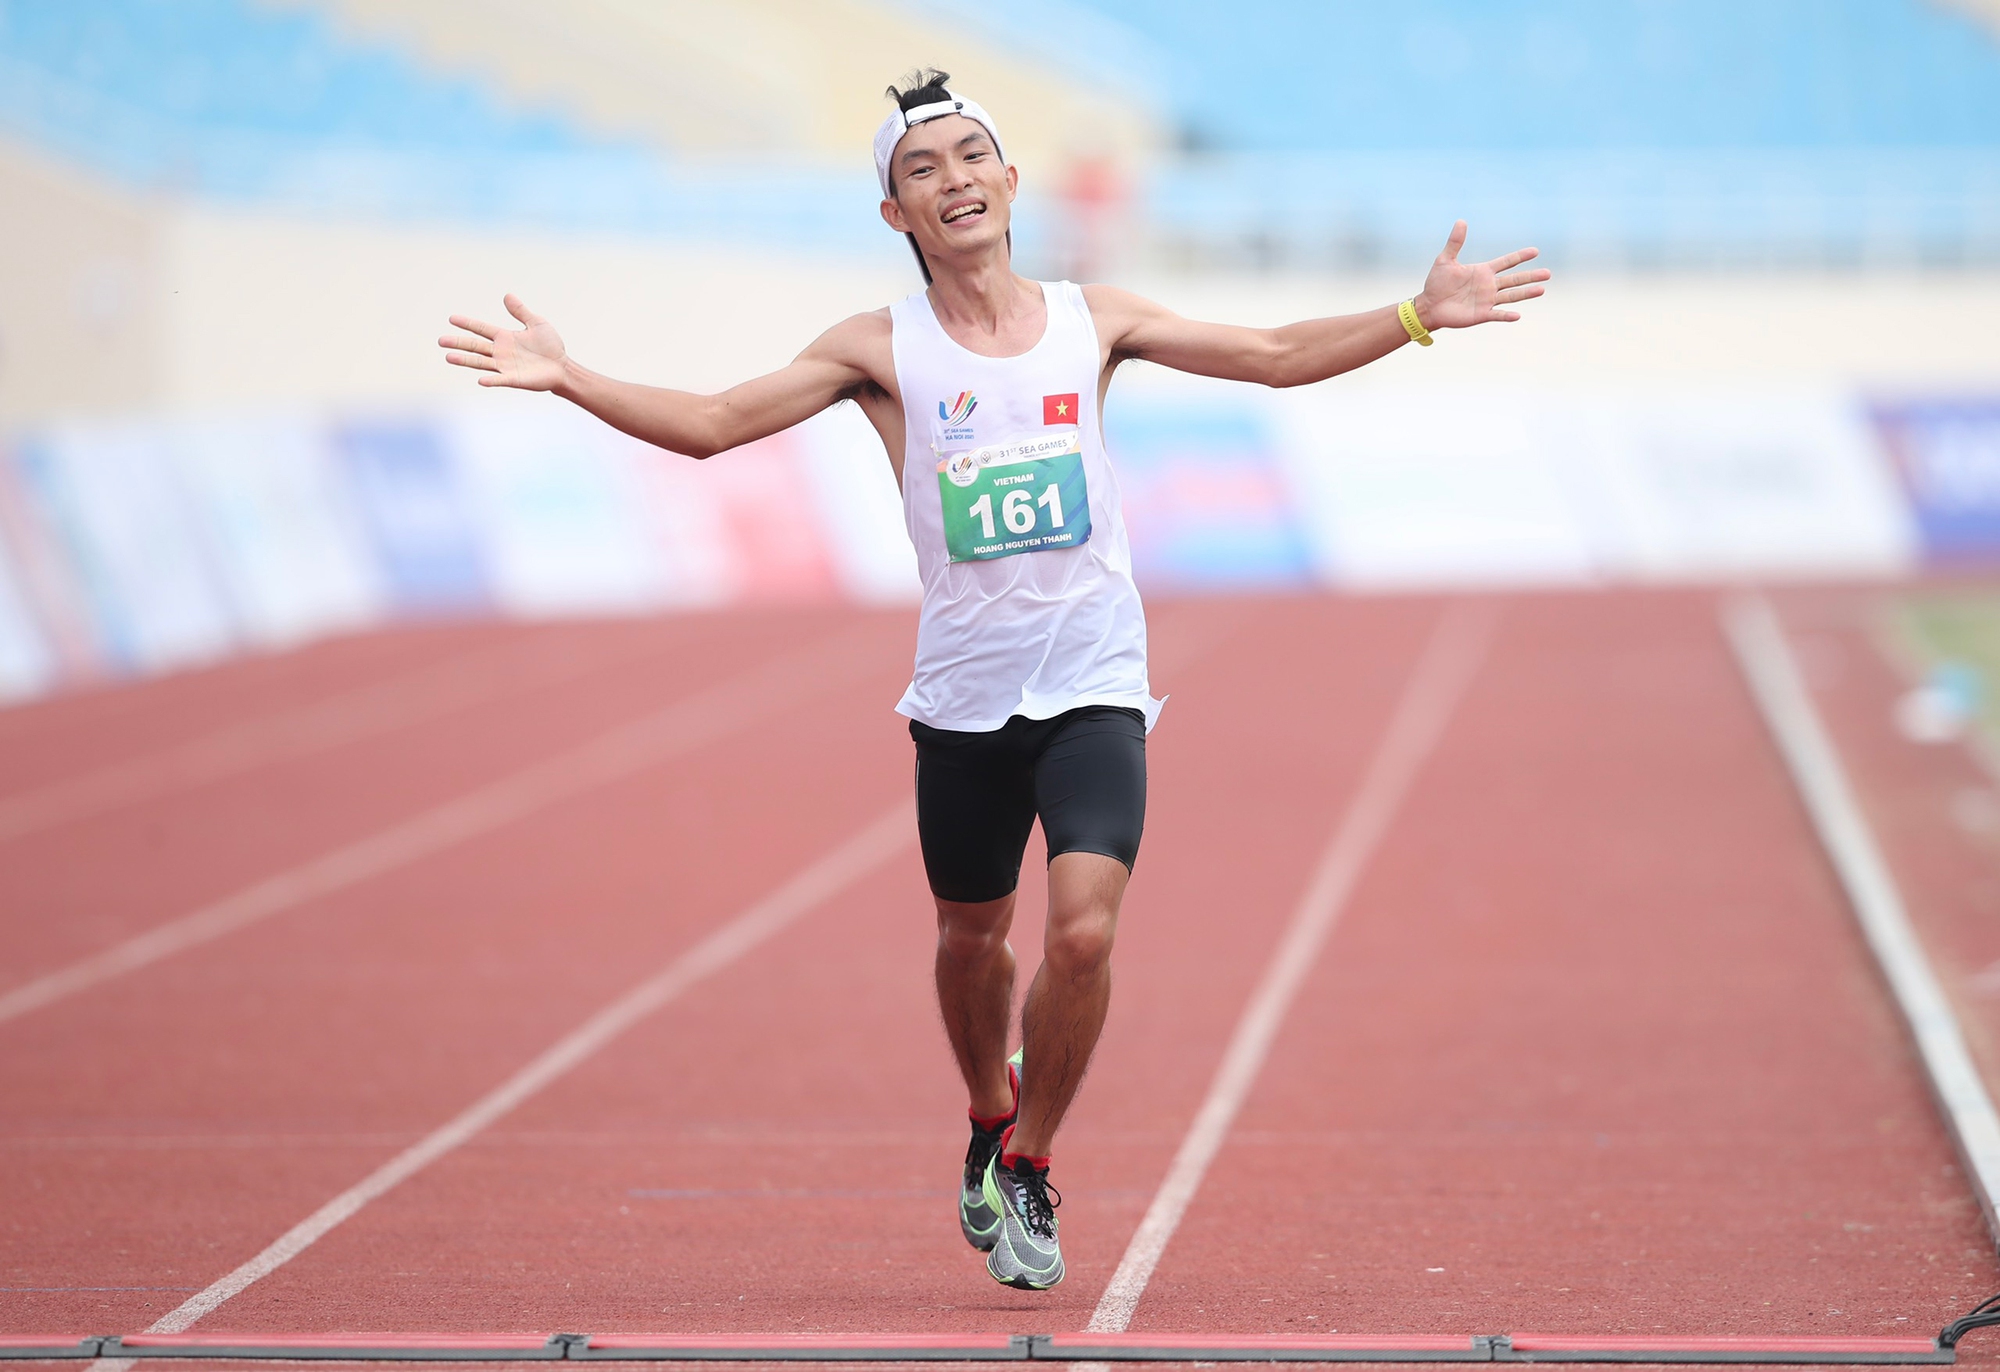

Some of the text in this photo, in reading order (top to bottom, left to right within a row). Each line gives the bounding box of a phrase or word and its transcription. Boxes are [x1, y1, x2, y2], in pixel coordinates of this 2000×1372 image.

[1018, 445, 1036, 455] SEA
[1038, 439, 1068, 452] GAMES
[993, 473, 1034, 487] VIETNAM
[969, 483, 1065, 539] 161
[973, 533, 1072, 555] HOANG NGUYEN THANH
